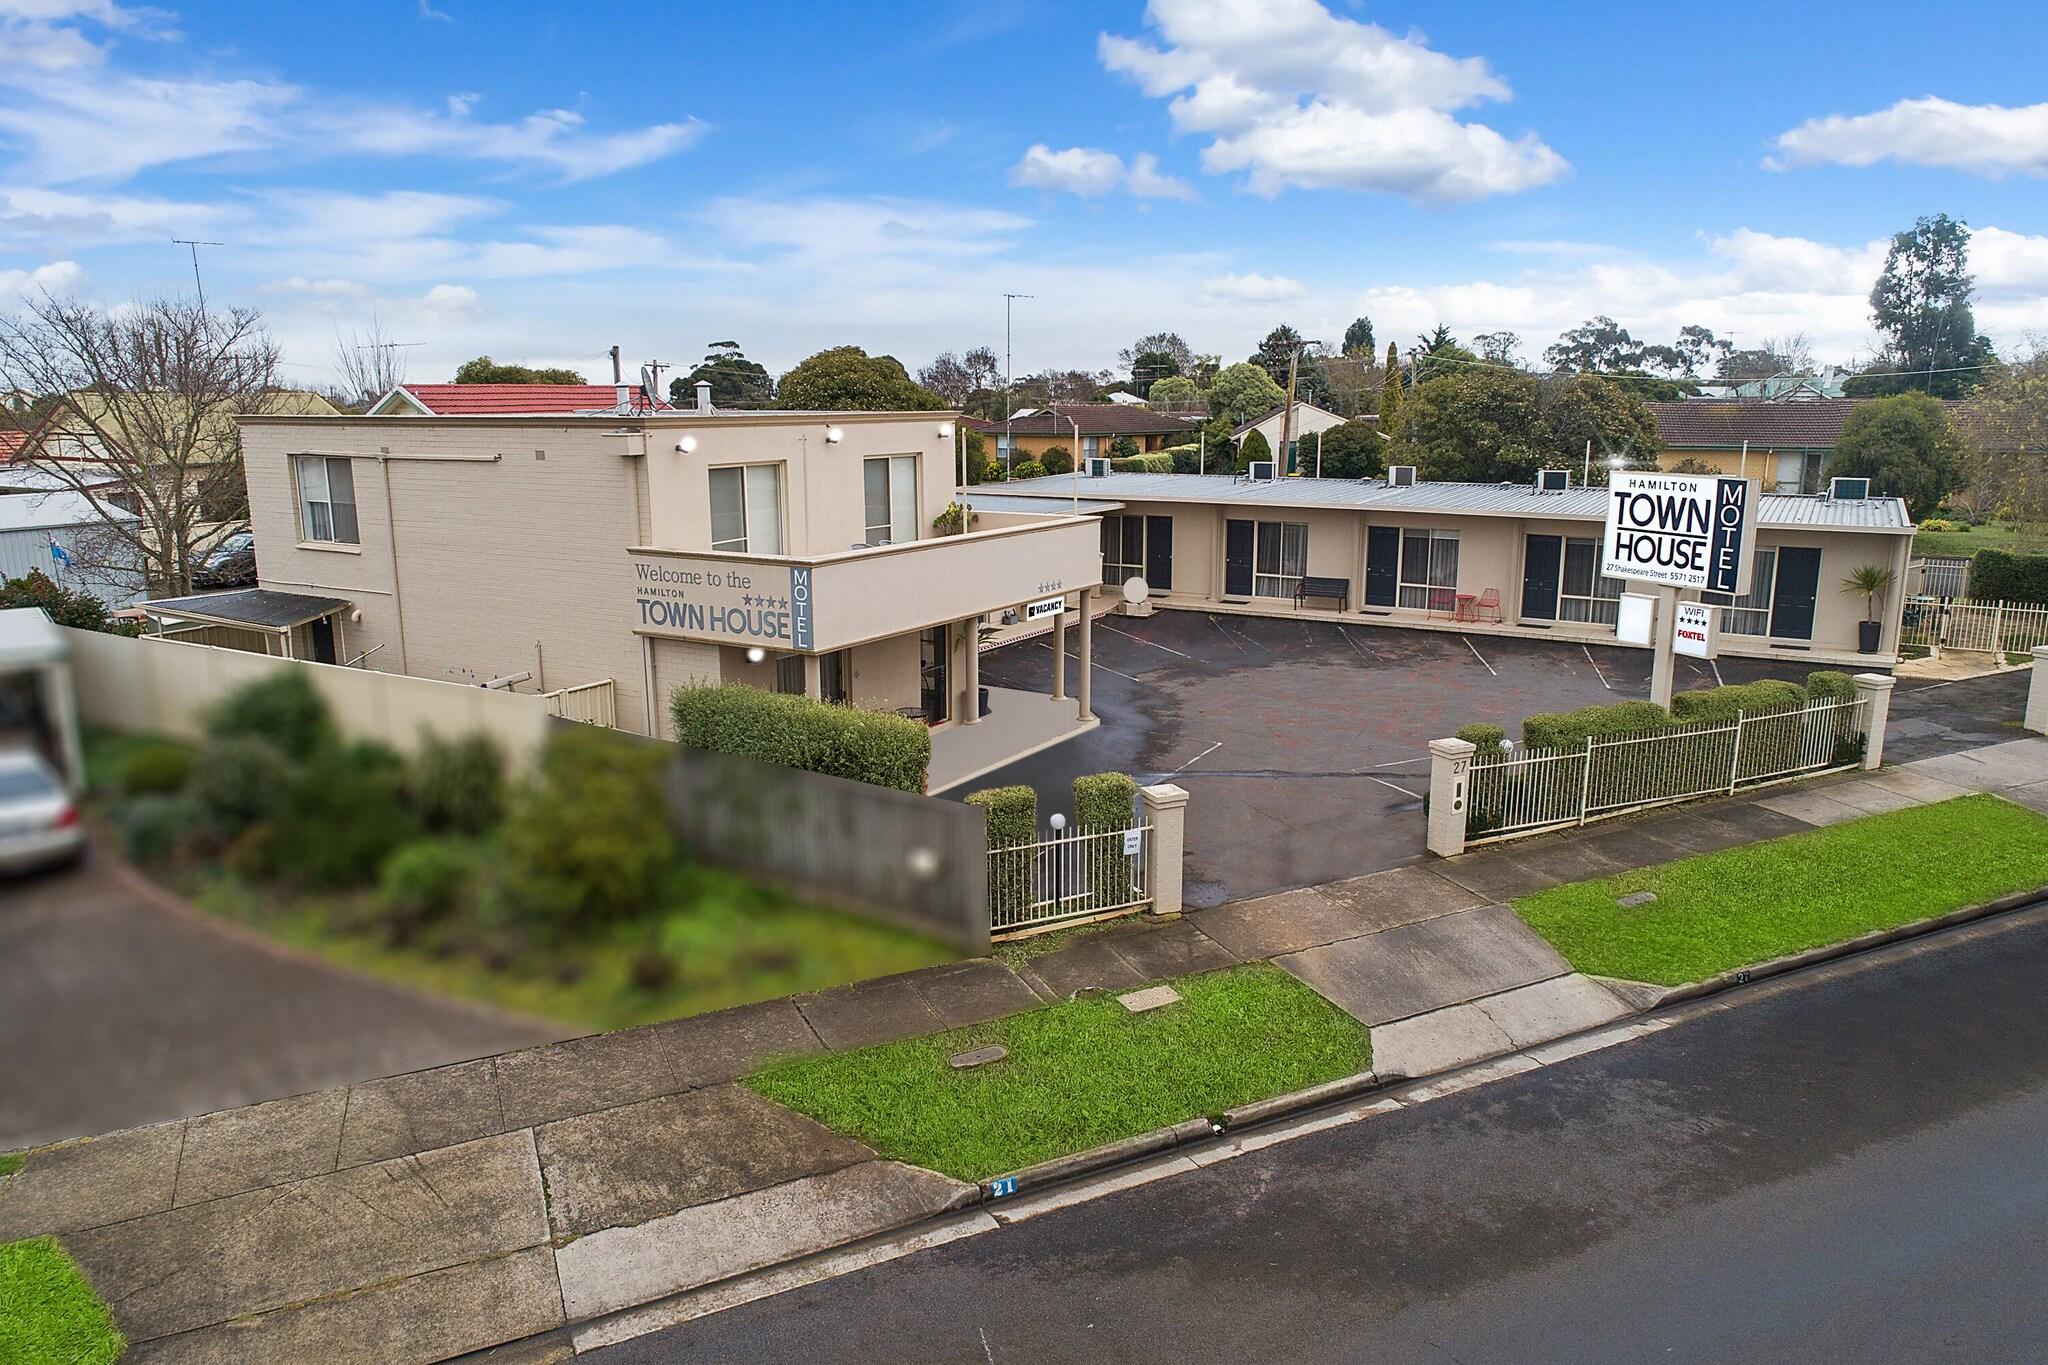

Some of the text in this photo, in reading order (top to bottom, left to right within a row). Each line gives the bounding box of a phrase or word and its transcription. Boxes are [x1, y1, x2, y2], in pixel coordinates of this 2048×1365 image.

[1629, 479, 1698, 493] HAMILTON
[1614, 491, 1712, 535] TOWN
[1716, 483, 1743, 590] MOTEL
[1615, 532, 1708, 572] HOUSE
[635, 563, 751, 589] Welcome to the
[1606, 563, 1705, 584] 27 Shakespeare Street 5571 2517
[637, 586, 684, 598] HAMILTON
[794, 569, 808, 648] MOTEL
[1036, 600, 1062, 614] VACANCY
[636, 598, 791, 640] TOWN HOUSE
[1677, 629, 1706, 642] FOXTEL
[1453, 760, 1467, 774] 27
[993, 1178, 1013, 1197] 21
